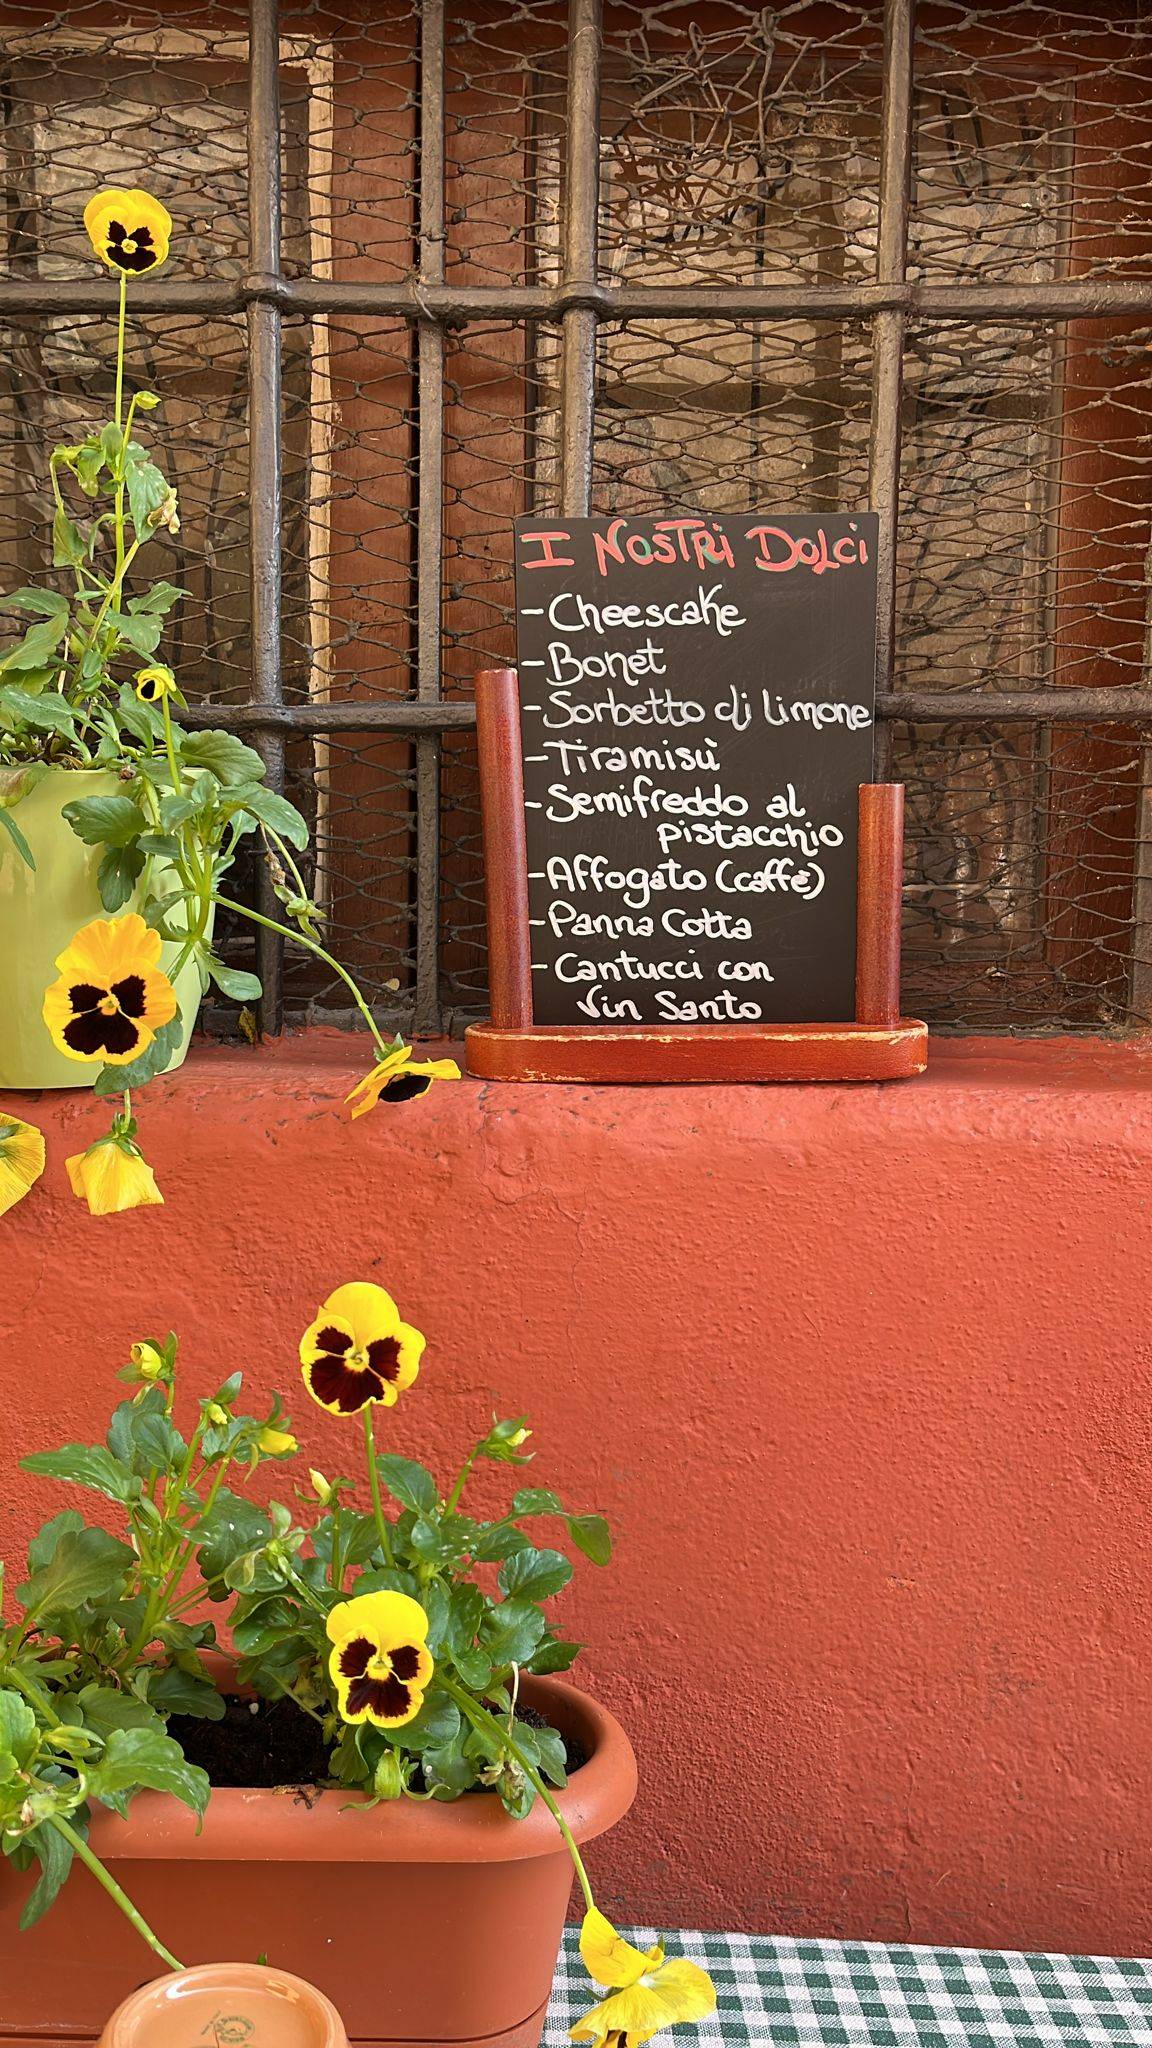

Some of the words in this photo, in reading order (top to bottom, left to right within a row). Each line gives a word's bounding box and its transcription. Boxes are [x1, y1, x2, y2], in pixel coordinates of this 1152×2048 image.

[520, 531, 574, 568] I
[714, 684, 751, 731] di
[762, 688, 873, 730] limone
[766, 783, 806, 818] al
[657, 820, 844, 857] pistacchio
[661, 907, 752, 940] Cotta
[718, 960, 774, 982] con
[576, 985, 642, 1020] Vin
[654, 990, 763, 1021] Santo
